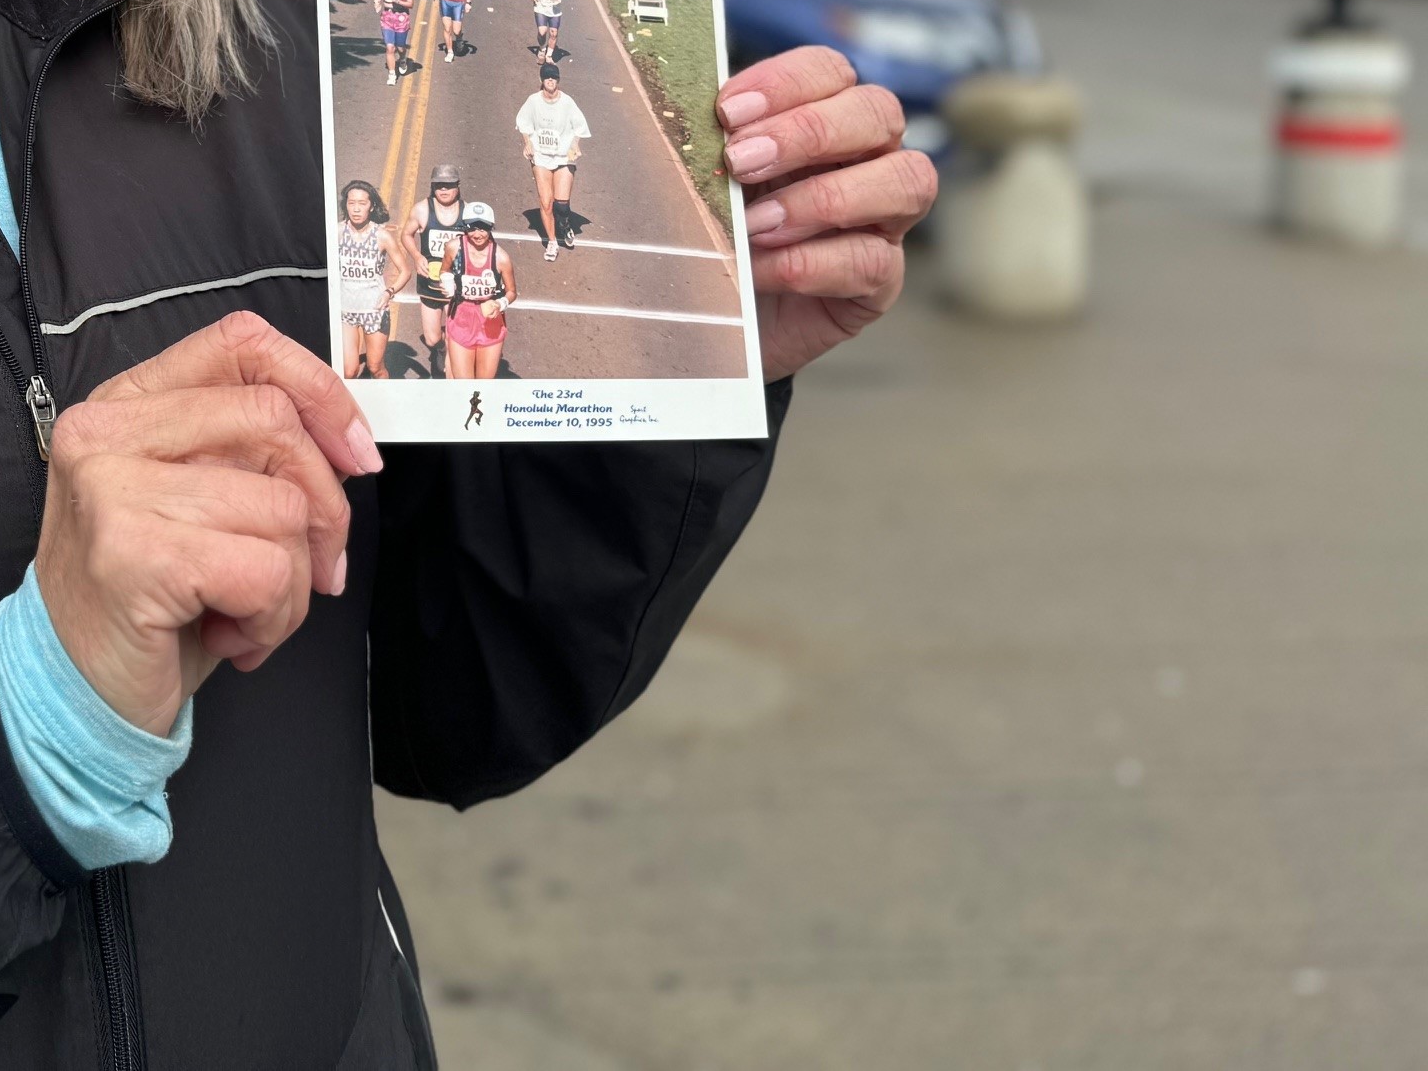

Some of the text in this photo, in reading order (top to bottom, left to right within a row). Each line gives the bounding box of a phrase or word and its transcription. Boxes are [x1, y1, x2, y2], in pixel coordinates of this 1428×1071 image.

[346, 259, 368, 267] JAL
[342, 266, 374, 279] 26045
[469, 278, 491, 286] JAL
[532, 390, 583, 399] The 23rd
[504, 404, 613, 414] Honolulu Marathon
[507, 418, 613, 428] December 10, 1995
